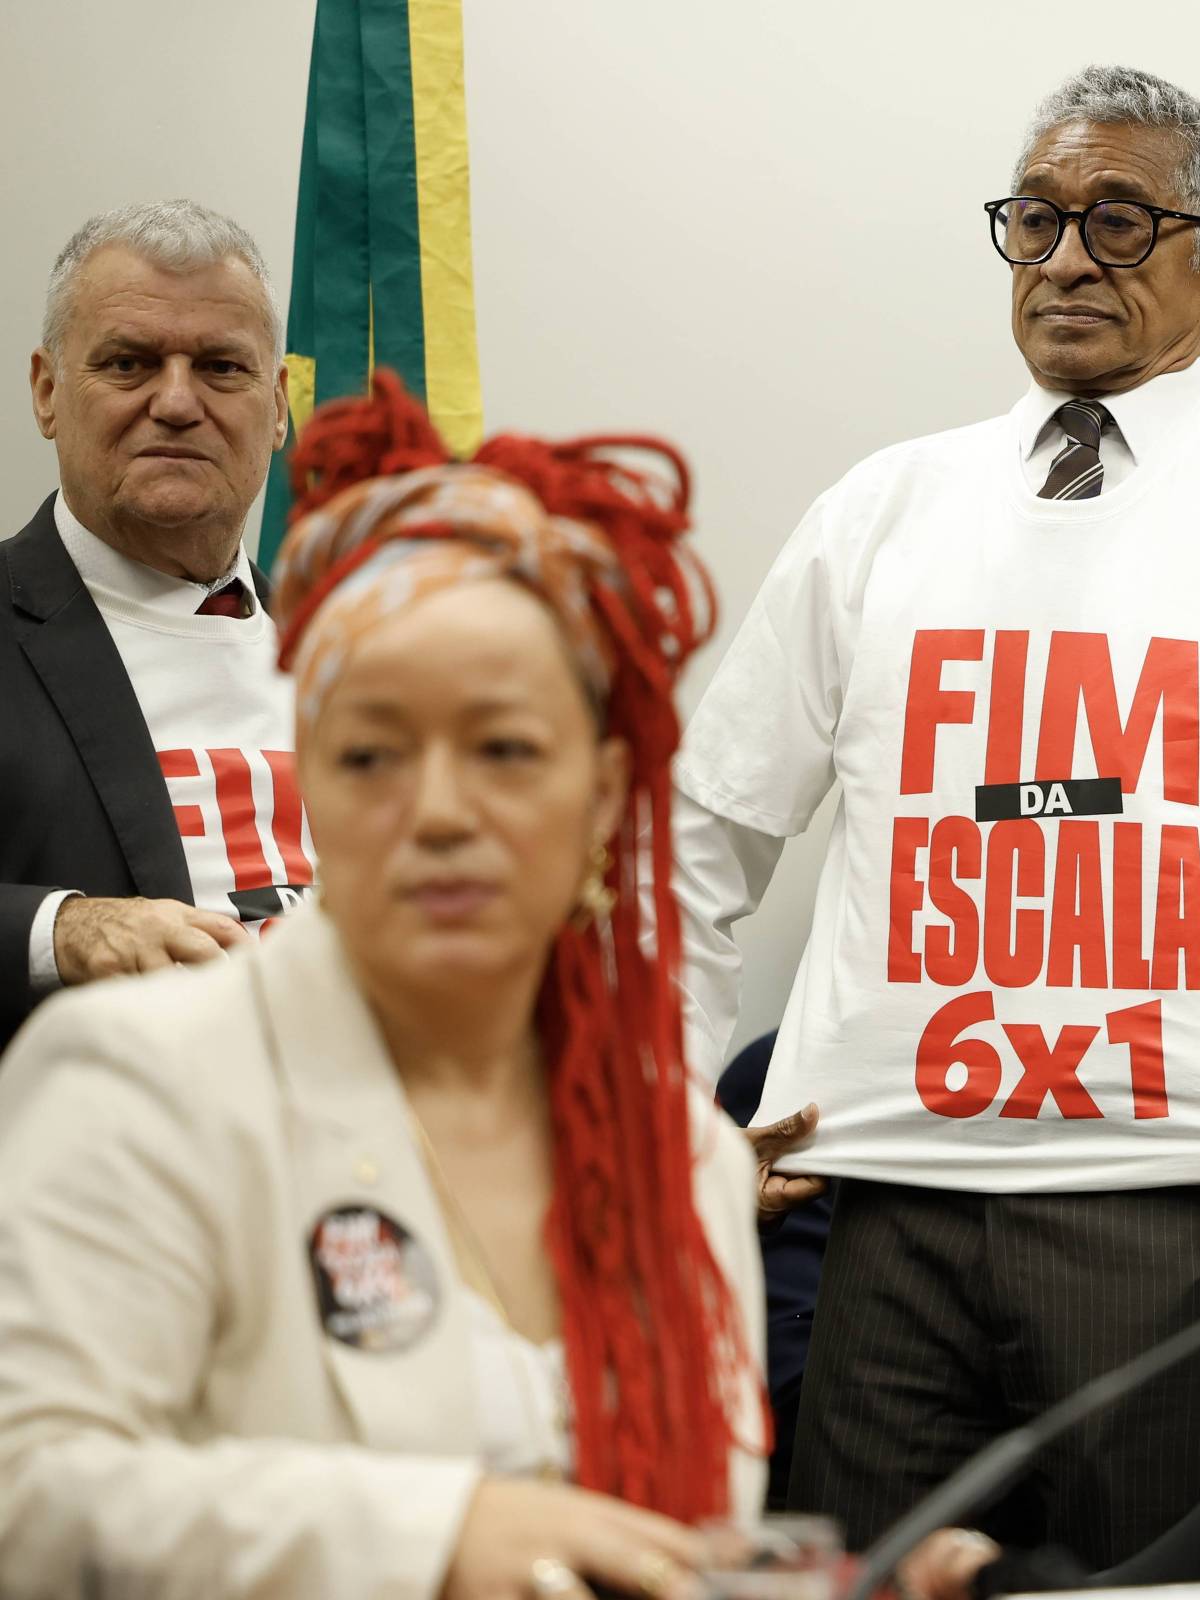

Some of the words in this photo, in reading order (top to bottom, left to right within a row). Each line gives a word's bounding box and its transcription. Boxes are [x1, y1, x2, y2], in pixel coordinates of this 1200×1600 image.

[900, 629, 1200, 806] FIM
[1019, 782, 1074, 816] DA
[914, 991, 1170, 1120] 6x1
